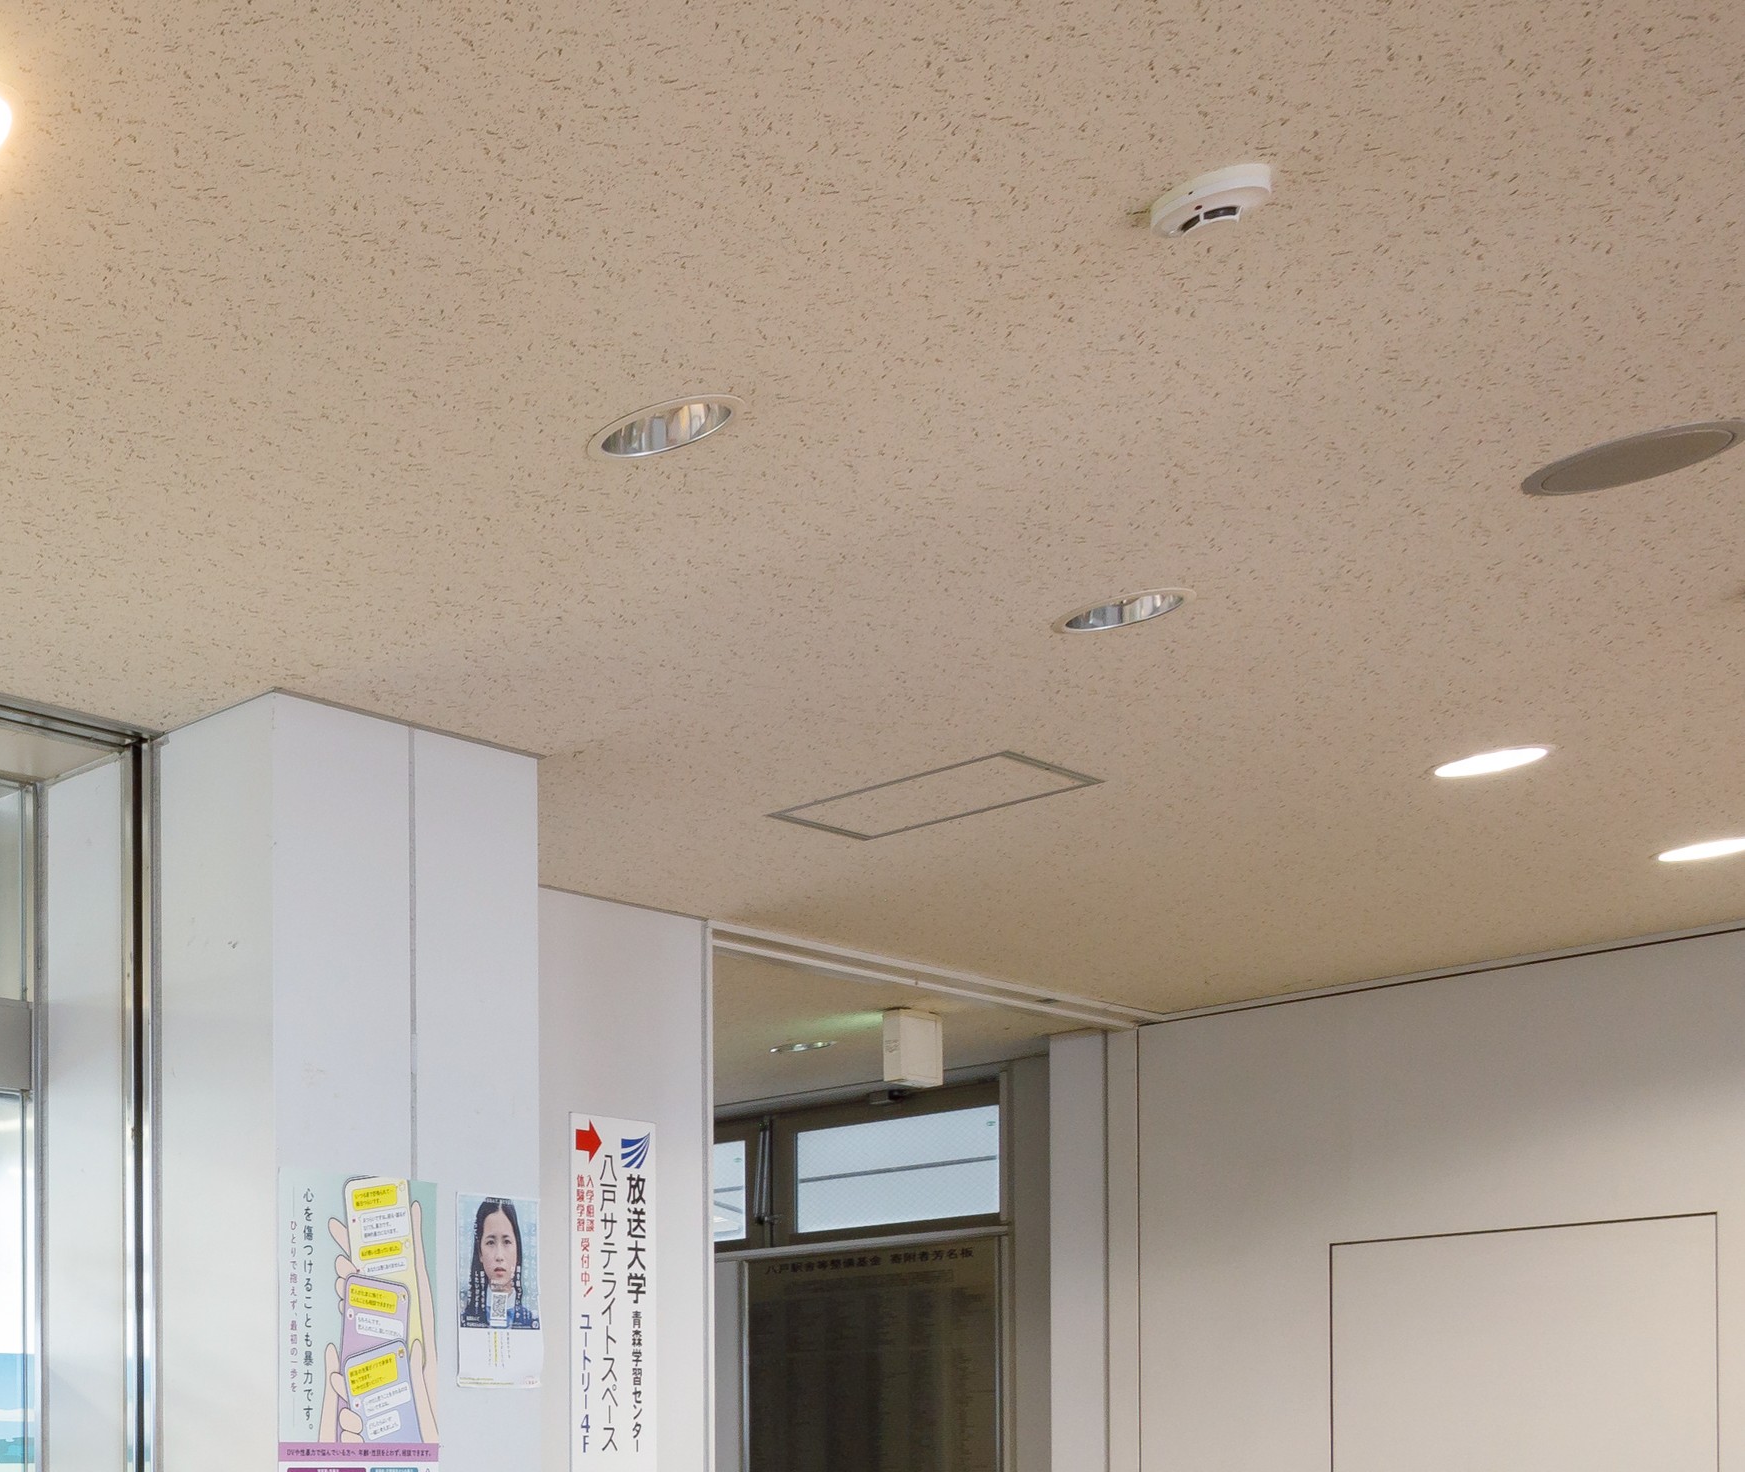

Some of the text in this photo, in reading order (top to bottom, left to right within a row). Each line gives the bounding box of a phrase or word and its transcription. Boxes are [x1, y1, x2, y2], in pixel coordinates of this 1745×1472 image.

[302, 1187, 315, 1431] 心を傷つけることも暴力です。
[576, 1174, 586, 1232] 体験学習
[585, 1174, 596, 1232] 入学相談
[599, 1154, 619, 1452] 八戸サテライトスペース
[626, 1173, 647, 1453] 放送大学 青森学習センター
